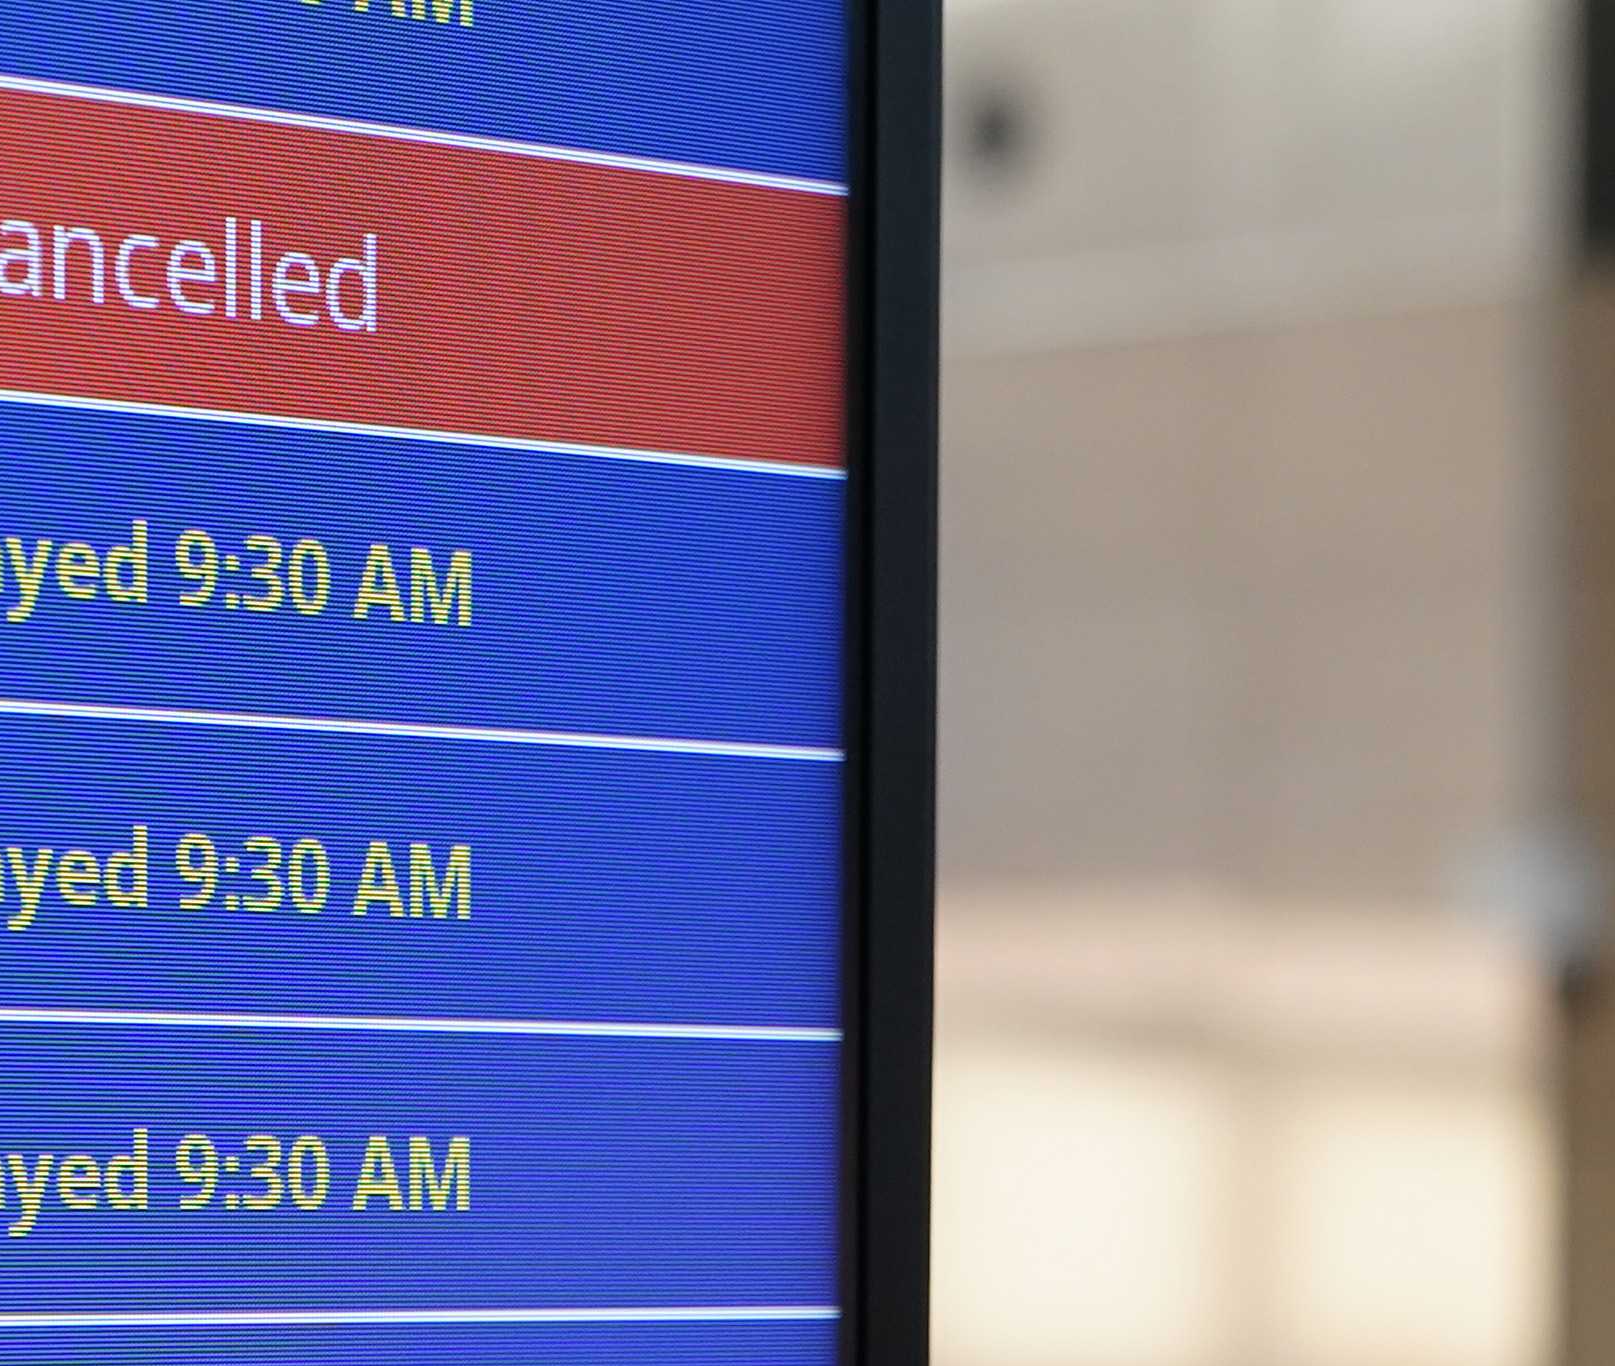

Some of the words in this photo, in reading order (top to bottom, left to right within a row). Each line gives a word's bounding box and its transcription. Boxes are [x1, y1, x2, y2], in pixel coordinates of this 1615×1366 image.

[177, 530, 329, 614] 9:30
[354, 544, 471, 626] AM
[177, 833, 329, 913] 9:30
[354, 841, 470, 919] AM
[177, 1134, 329, 1210] 9:30
[353, 1135, 470, 1211] AM
